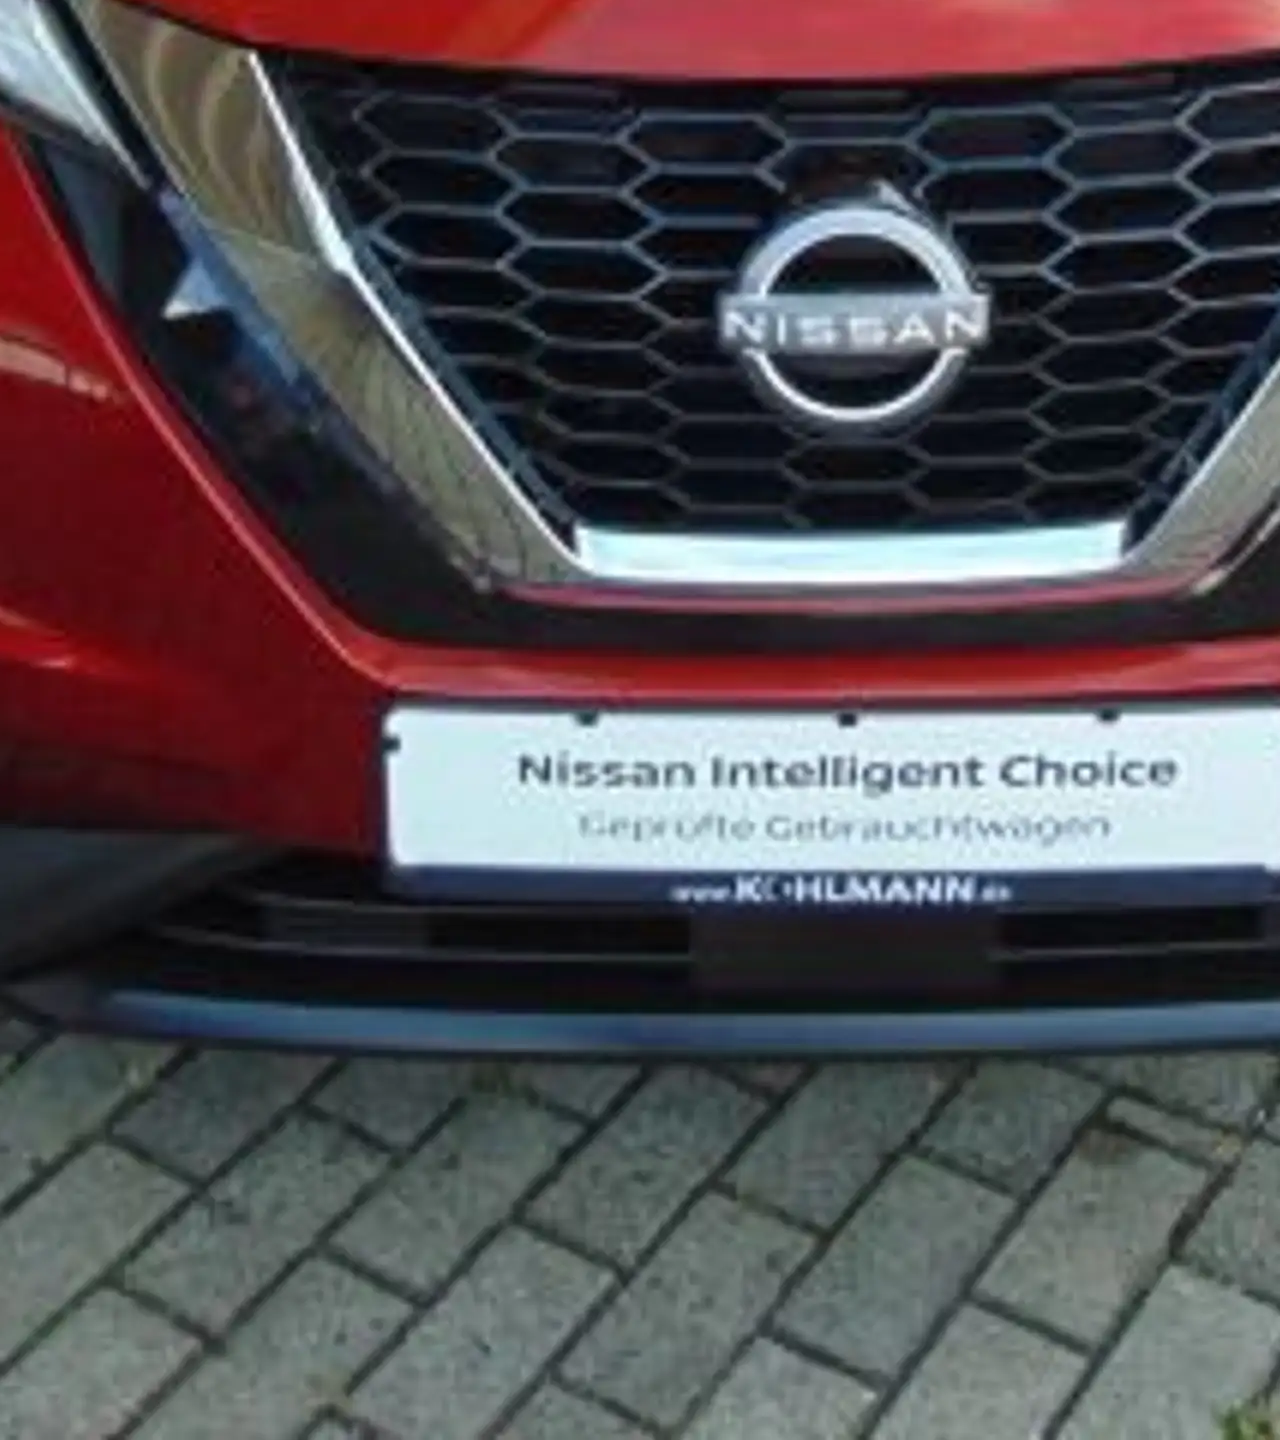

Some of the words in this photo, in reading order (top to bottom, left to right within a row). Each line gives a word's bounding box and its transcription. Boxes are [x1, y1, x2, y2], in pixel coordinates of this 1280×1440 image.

[723, 306, 985, 346] NISSAN
[519, 749, 696, 790] Nissan
[710, 750, 985, 798] Intelligent
[998, 748, 1179, 790] Choice
[577, 812, 757, 844] Geprüfte
[765, 812, 1112, 847] Gebrauchtwagen
